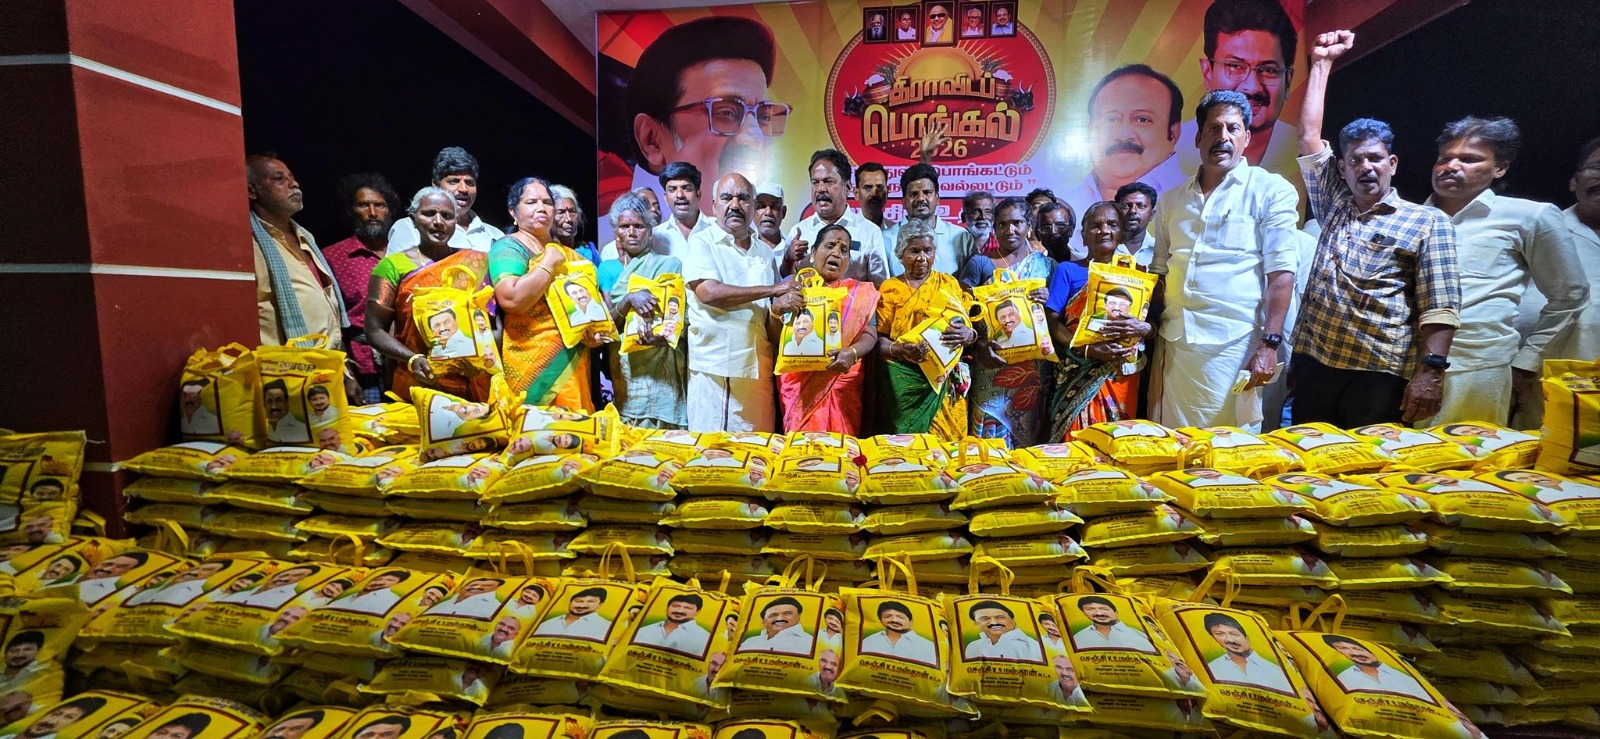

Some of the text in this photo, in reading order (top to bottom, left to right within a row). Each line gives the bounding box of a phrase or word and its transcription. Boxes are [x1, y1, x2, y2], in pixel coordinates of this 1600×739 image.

[889, 71, 995, 107] திராவிடப்
[863, 101, 1021, 146] பொங்கல்
[910, 138, 968, 159] 226
[940, 180, 1023, 193] வல்லட்டும்
